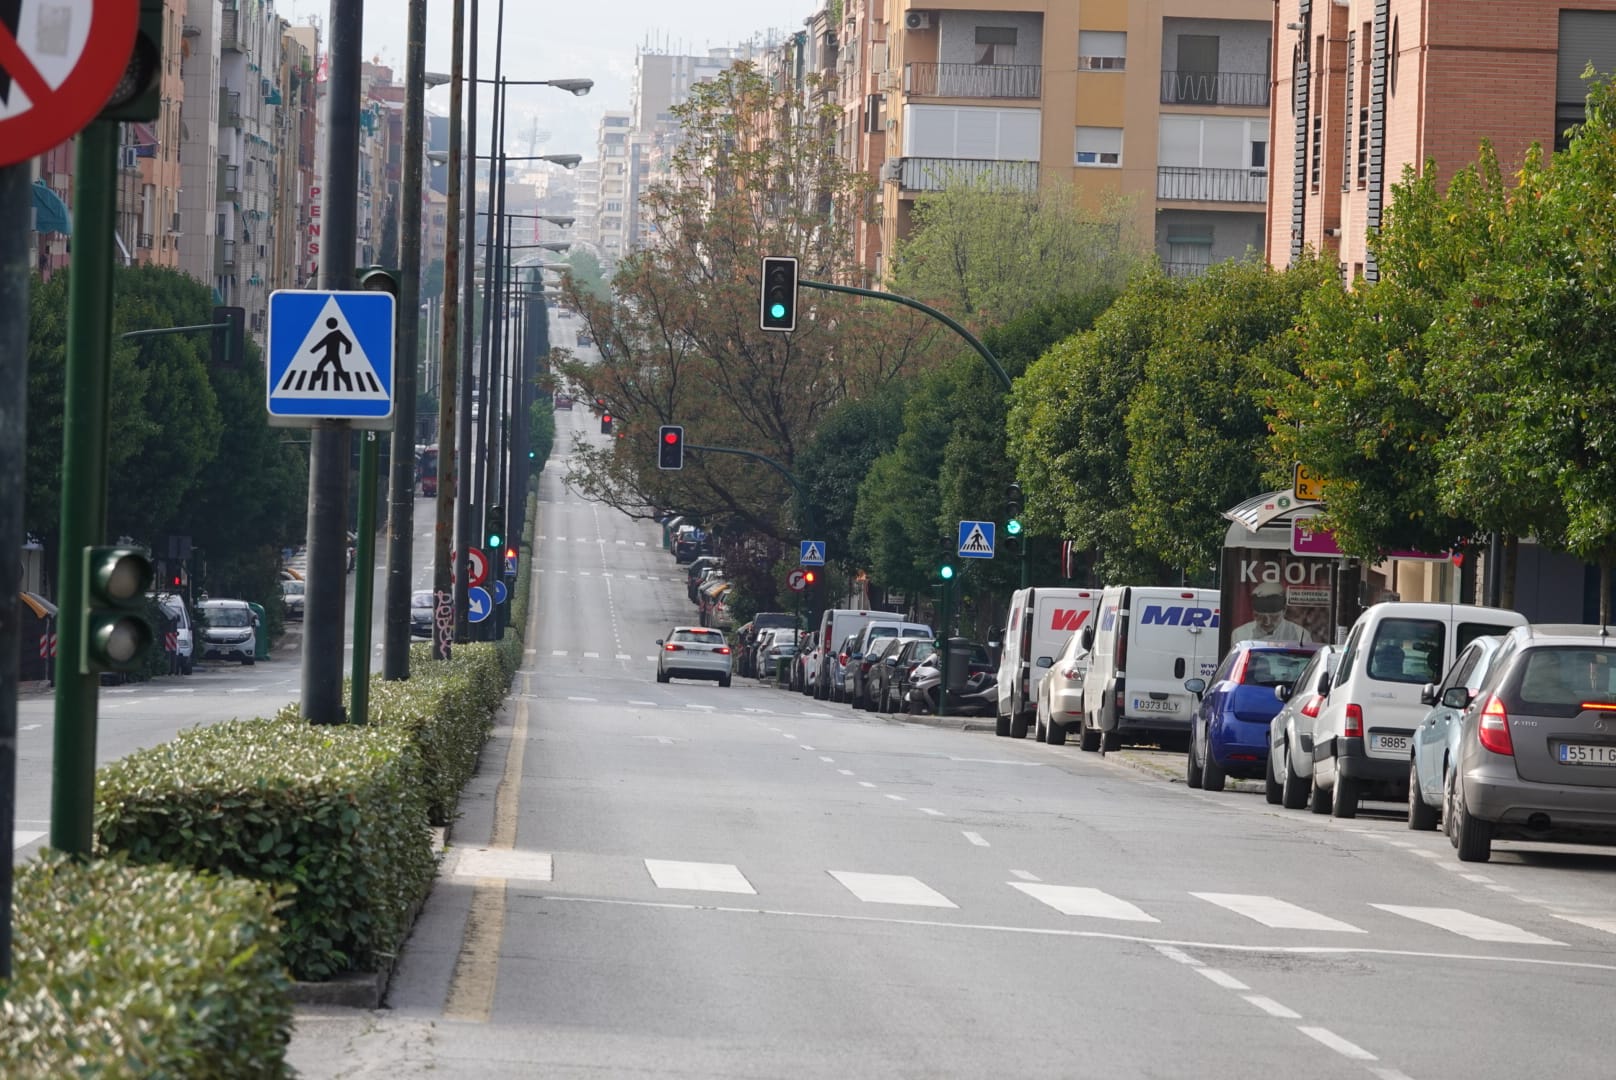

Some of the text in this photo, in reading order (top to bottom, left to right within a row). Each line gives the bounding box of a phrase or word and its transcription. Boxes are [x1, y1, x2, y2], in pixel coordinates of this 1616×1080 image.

[1139, 700, 1180, 711] 0373 DLY
[1380, 736, 1407, 749] 9885
[1569, 747, 1603, 760] 5511
